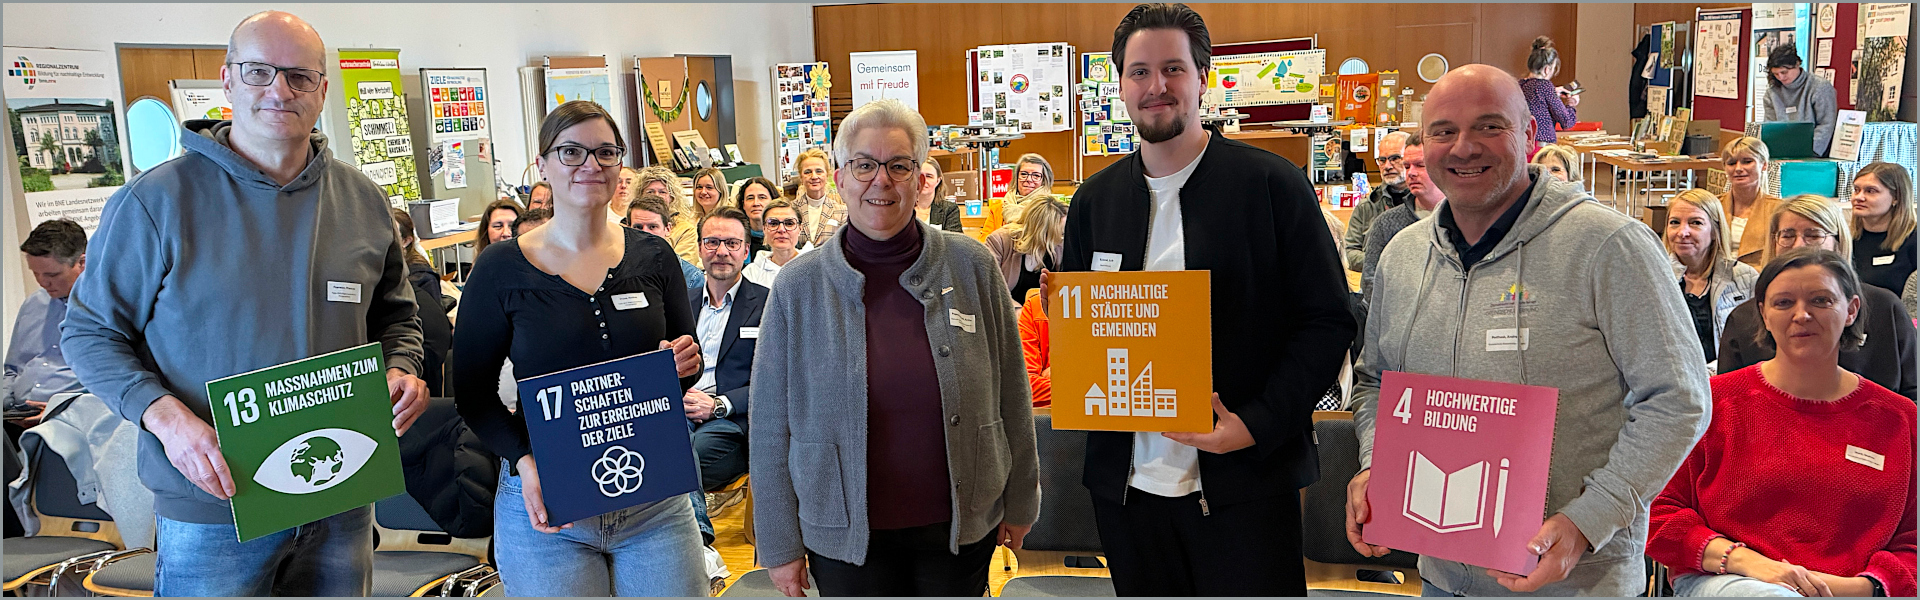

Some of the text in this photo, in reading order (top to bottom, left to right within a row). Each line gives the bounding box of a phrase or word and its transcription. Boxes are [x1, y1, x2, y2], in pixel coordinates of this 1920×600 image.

[430, 75, 446, 84] ZIELE
[857, 62, 911, 74] Gemeinsam
[860, 78, 910, 90] mit Freude
[61, 207, 89, 216] gemeinsam
[65, 196, 104, 206] Landesnetzwerk
[1058, 284, 1169, 318] 11 NACHHALTIGE
[1091, 302, 1159, 318] STÄDTE UND
[1091, 322, 1156, 337] GEMEINDEN
[264, 356, 379, 398] MASSNAHMEN ZUM
[570, 372, 625, 396] PARTNER-
[223, 381, 354, 427] 13 KLIMASCHUTZ
[536, 385, 633, 421] 17 SCHAFTEN
[578, 397, 671, 431] ZUR ERREICHUNG
[1392, 387, 1518, 424] 4 HOCHWERTIGE
[1423, 410, 1478, 432] BILDUNG
[581, 422, 635, 448] DER ZIELE
